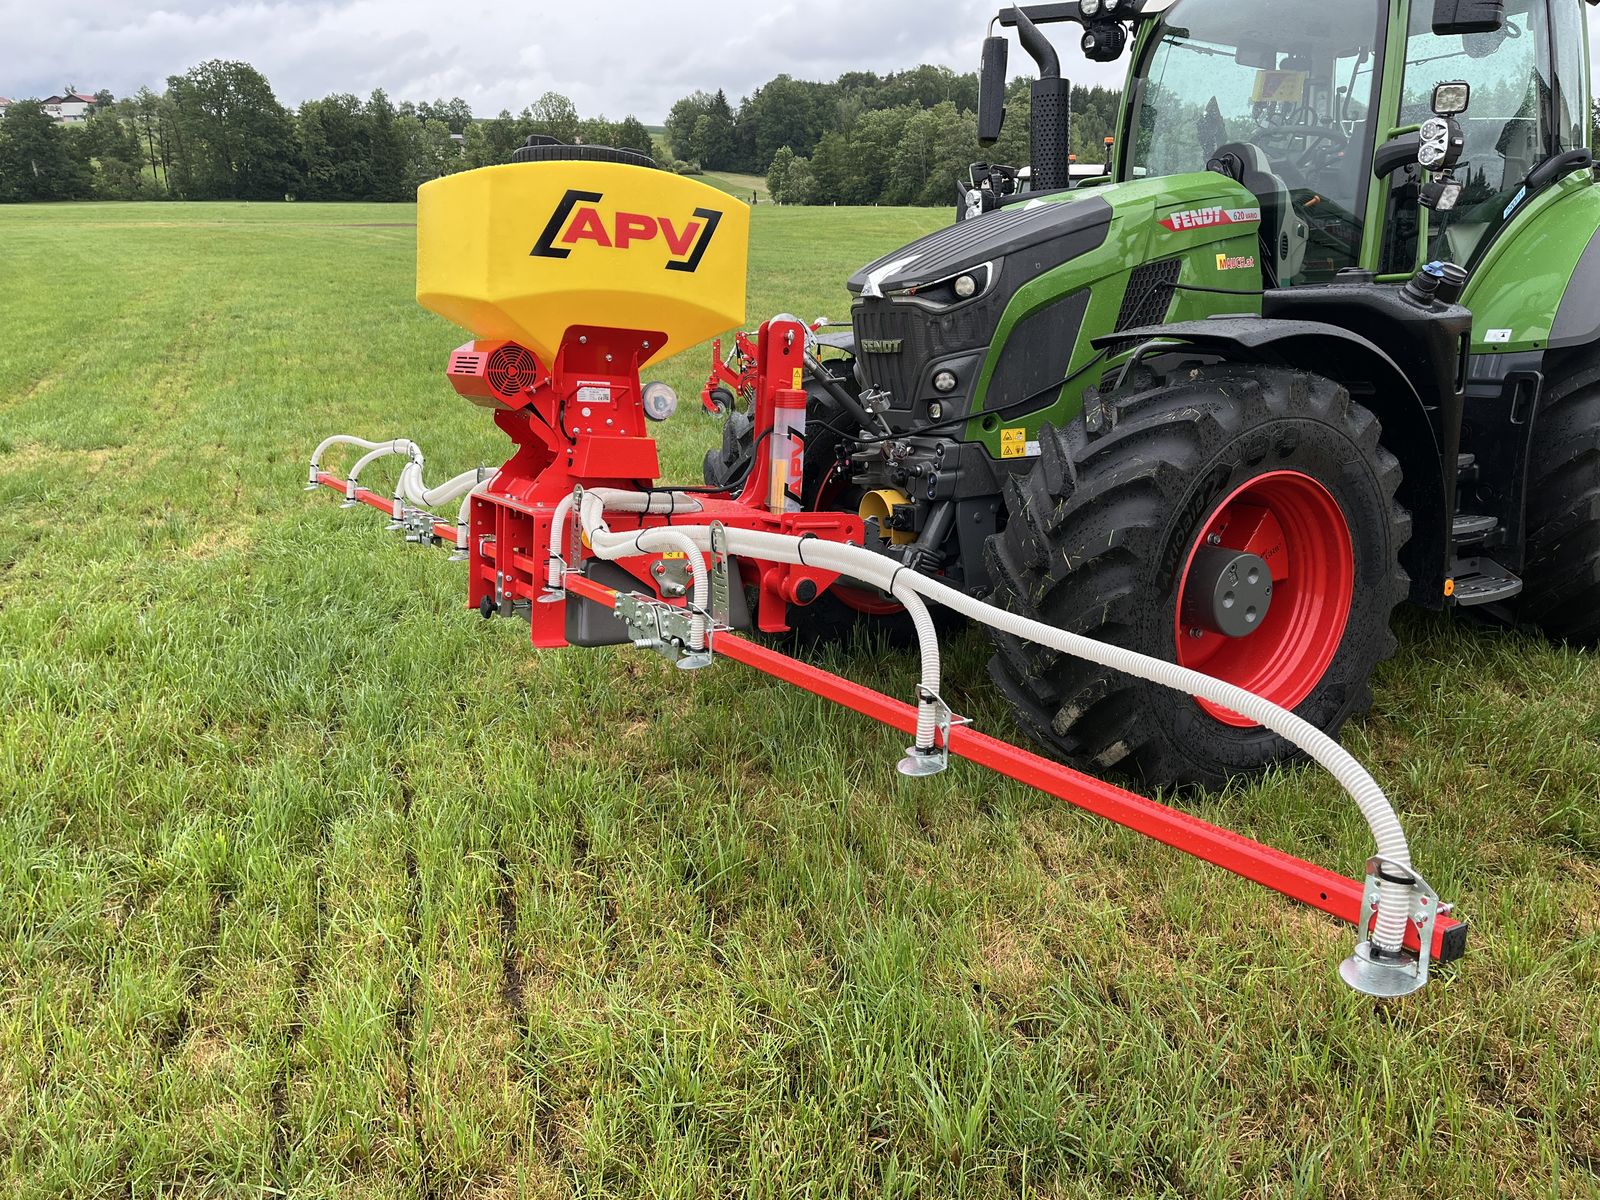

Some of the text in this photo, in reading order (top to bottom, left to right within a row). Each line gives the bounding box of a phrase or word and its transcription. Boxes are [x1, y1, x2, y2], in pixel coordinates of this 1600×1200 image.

[1170, 206, 1222, 229] FENDT
[1233, 212, 1244, 221] 620
[561, 207, 701, 256] APV
[1219, 257, 1254, 270] MAUCH.at
[861, 339, 903, 353] FENDT
[788, 434, 804, 498] APV
